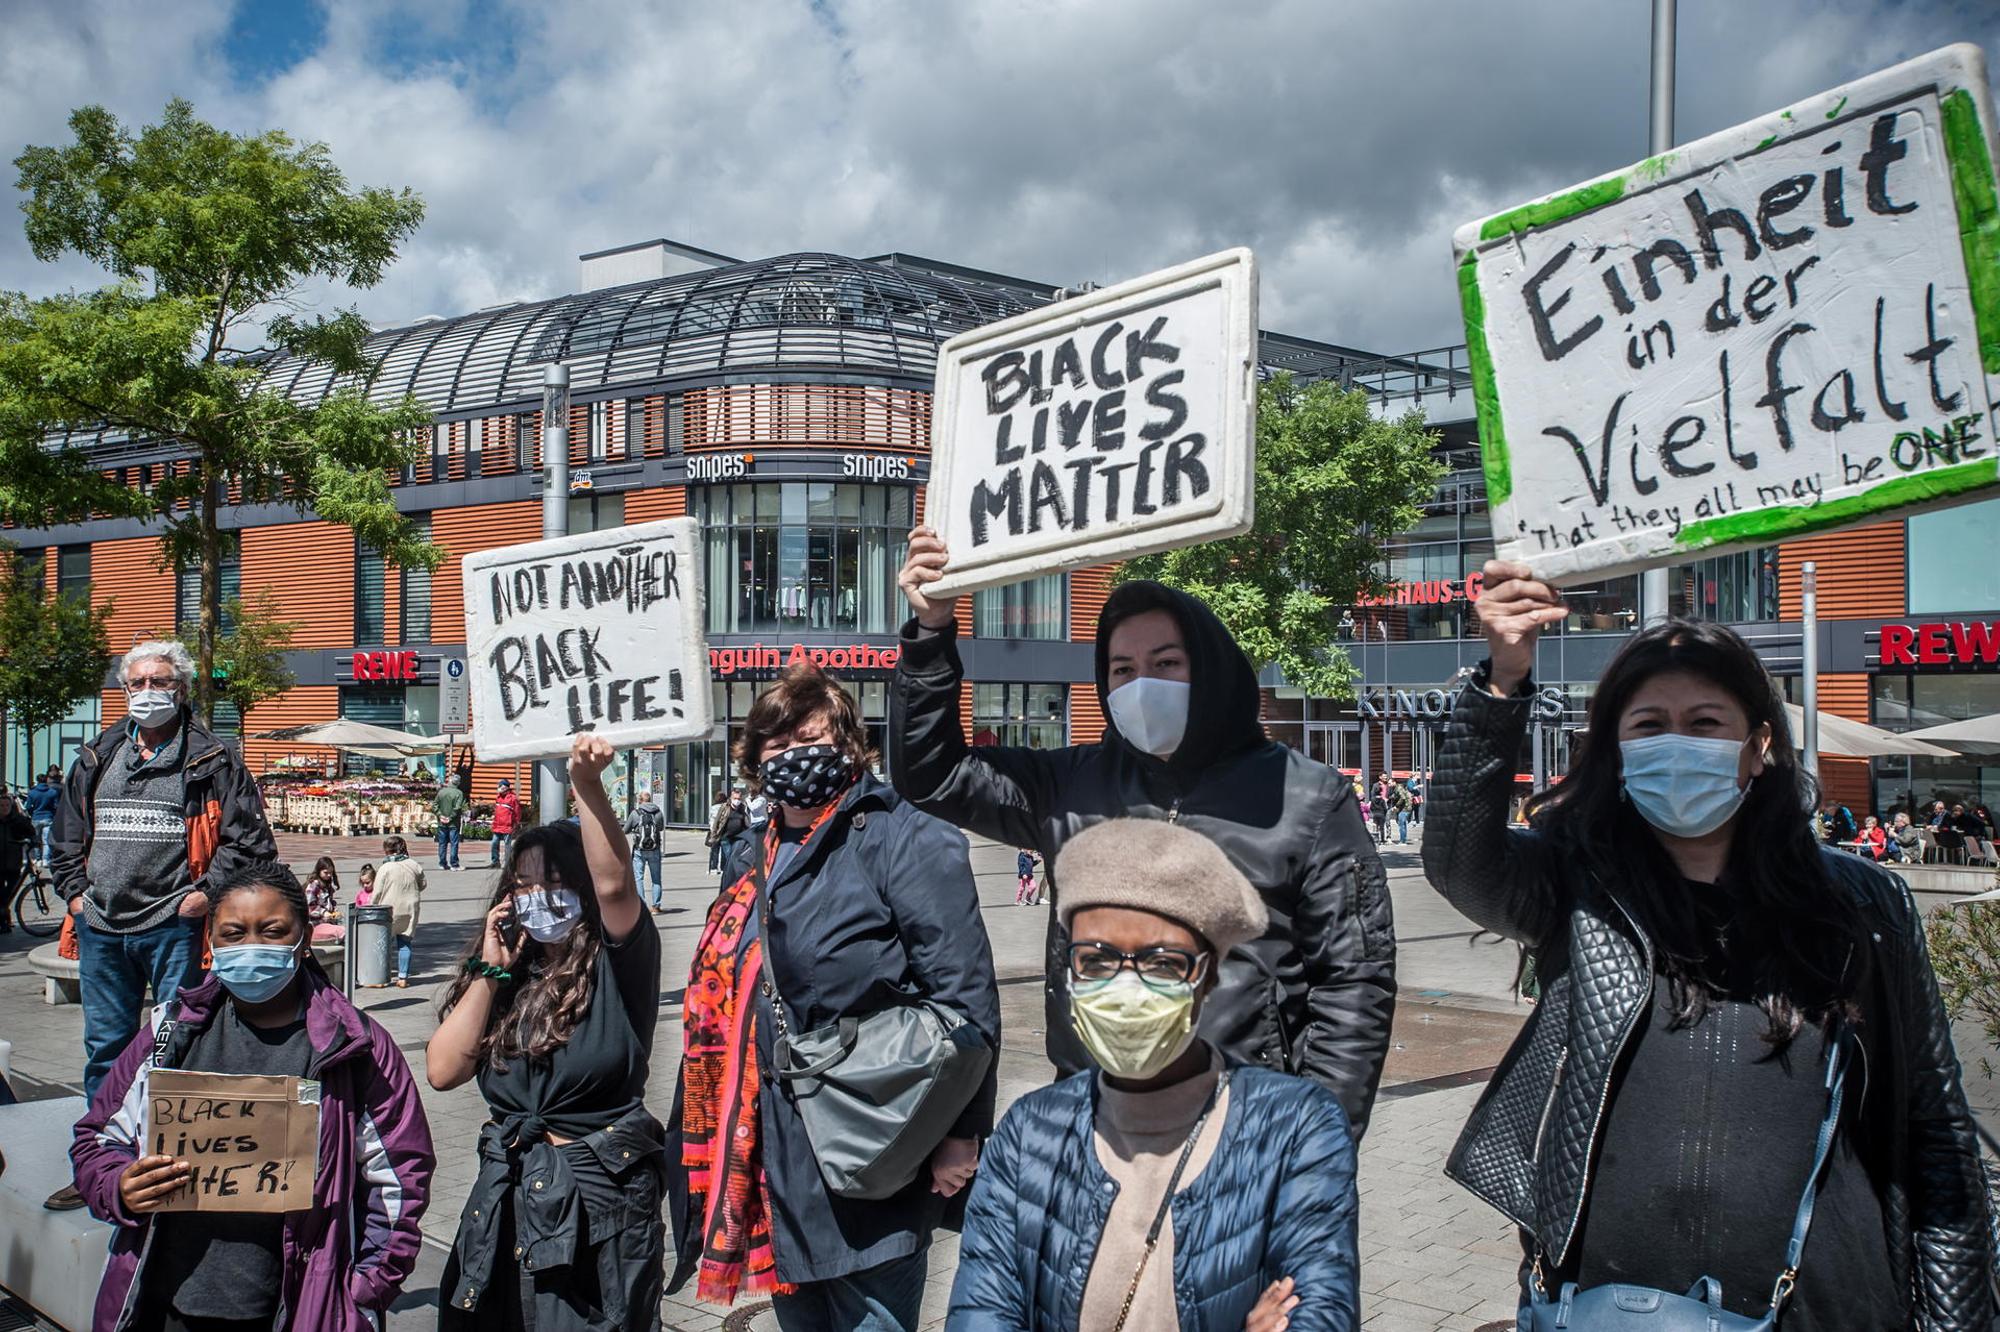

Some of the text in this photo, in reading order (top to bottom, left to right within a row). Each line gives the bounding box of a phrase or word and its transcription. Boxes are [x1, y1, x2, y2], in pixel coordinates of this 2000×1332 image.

[1522, 112, 1920, 361] Einheit
[1625, 256, 1821, 370] in der
[981, 316, 1181, 415] BLACK
[1542, 282, 1964, 507] Vielfalt
[995, 369, 1189, 465] LIVES
[687, 453, 745, 482] snipes
[843, 453, 909, 482] snipes
[970, 432, 1211, 548] MATTER
[1610, 504, 1682, 538] they
[1694, 482, 1742, 517] all
[1756, 472, 1823, 508] may
[1842, 453, 1884, 485] be
[1890, 412, 1987, 472] ONE
[490, 546, 680, 625] NOT ANOTHER
[353, 651, 417, 680] REWE
[489, 626, 612, 722] BLACK
[708, 642, 903, 674] nguin Apothe
[1880, 621, 2000, 665] REW
[566, 668, 685, 736] LIFE!
[152, 1097, 256, 1126] BLACK
